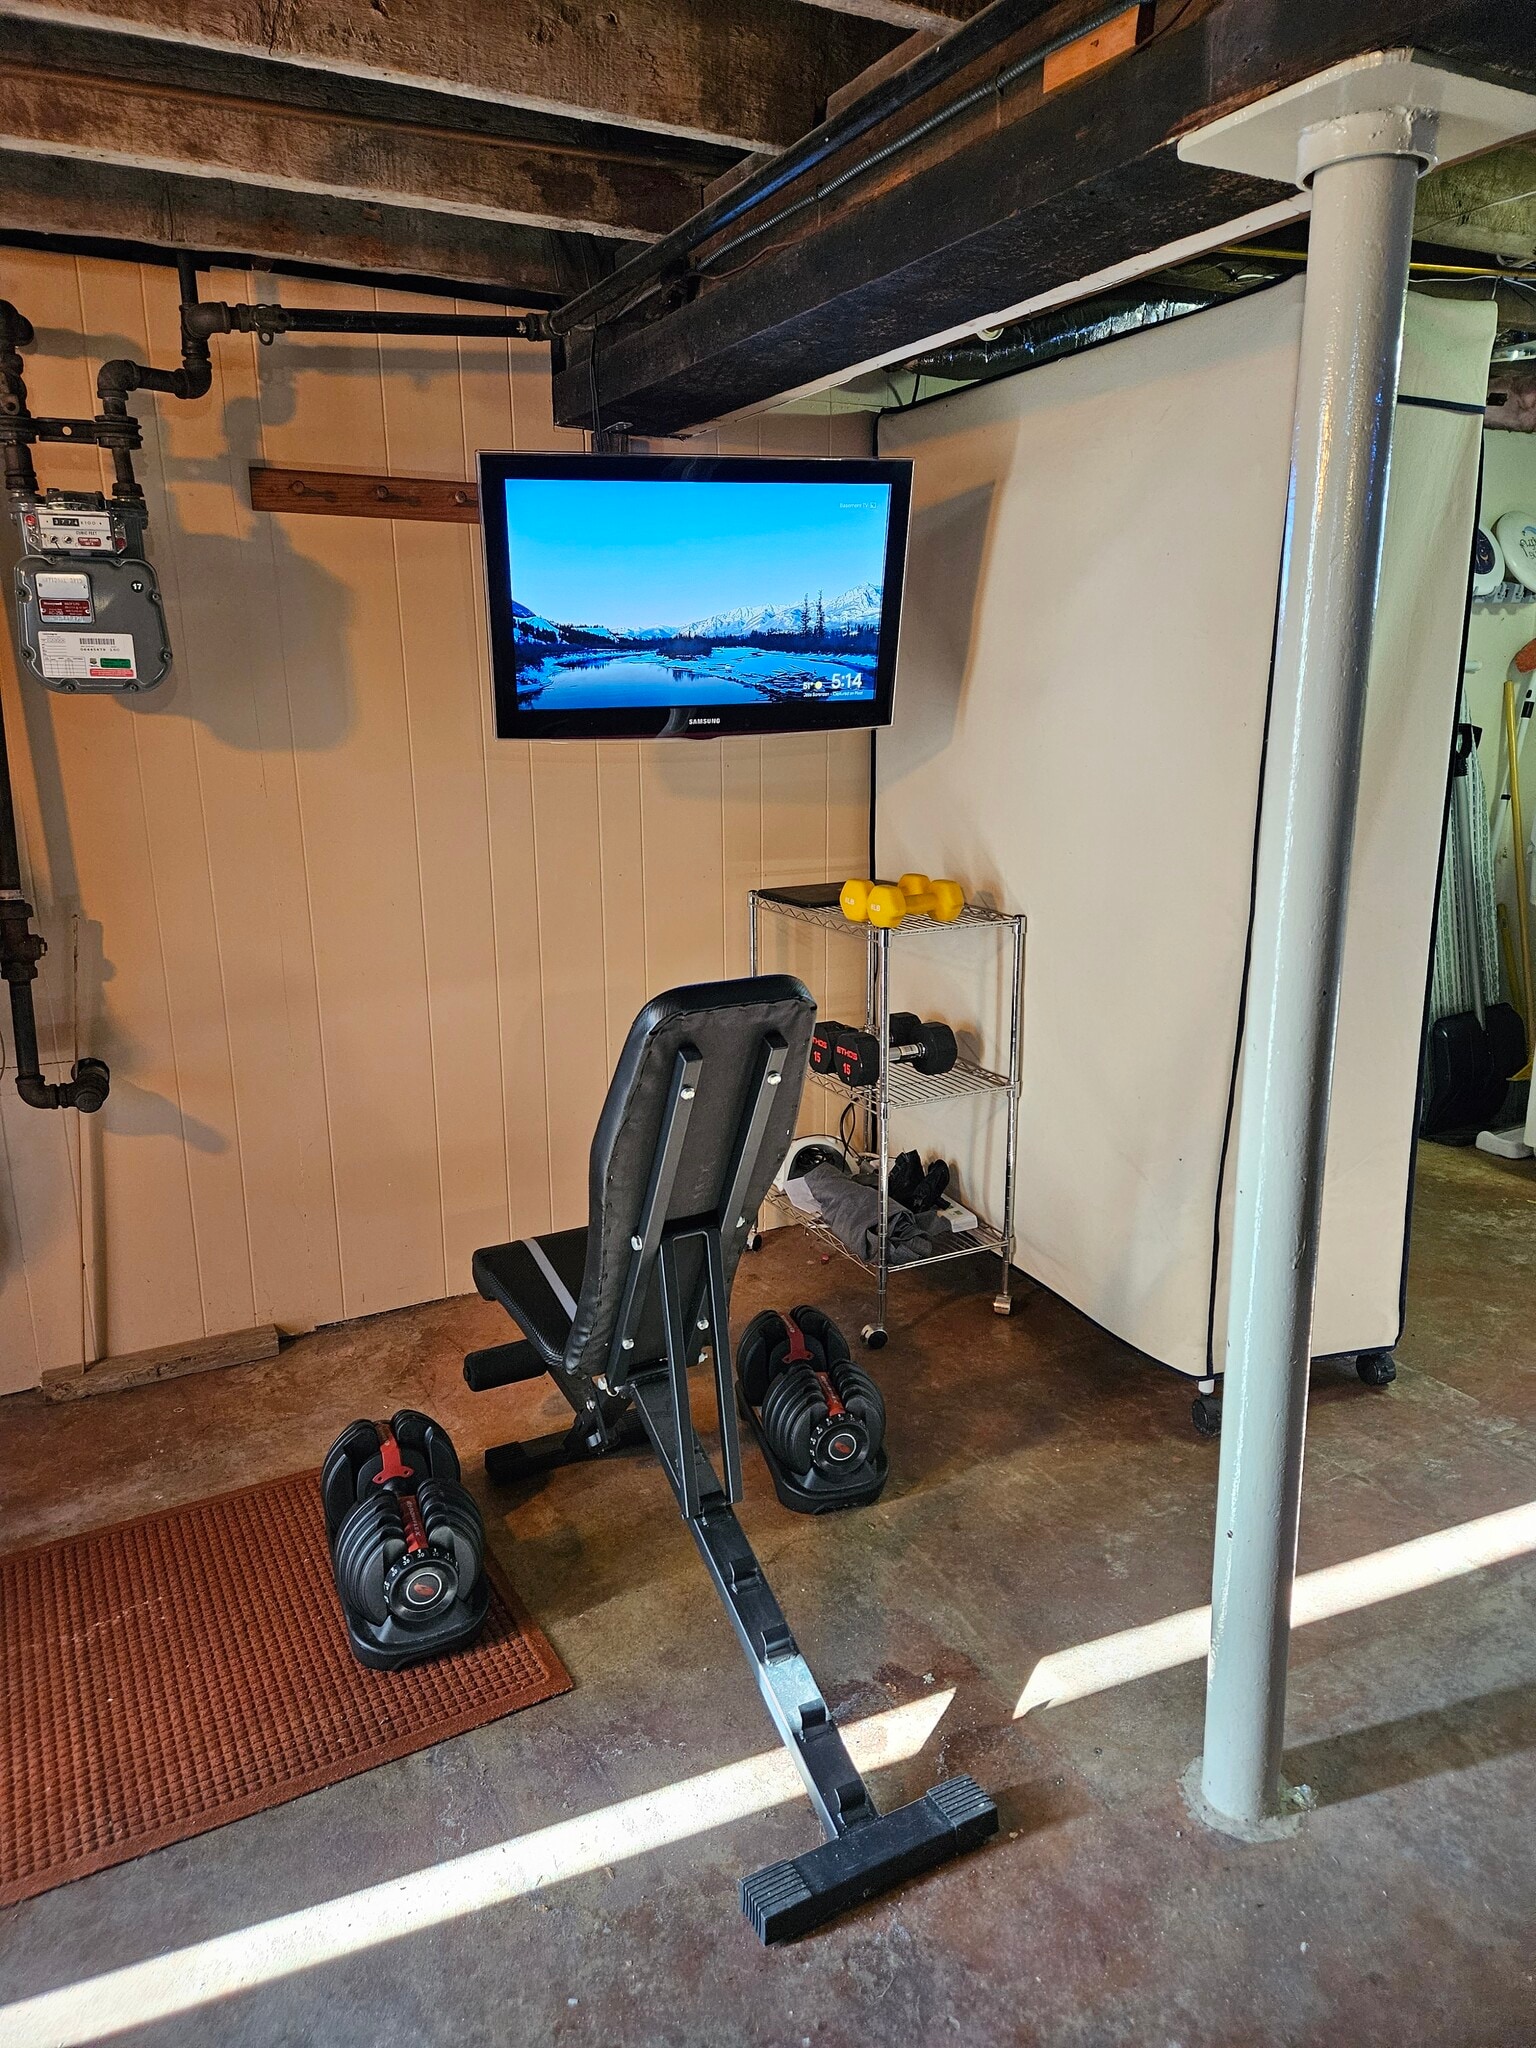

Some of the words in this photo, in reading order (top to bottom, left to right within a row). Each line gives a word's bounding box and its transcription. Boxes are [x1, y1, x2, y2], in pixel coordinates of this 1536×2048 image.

[831, 673, 862, 689] 5:14
[688, 717, 721, 725] SAMSUNG
[812, 1036, 828, 1049] THOS
[813, 1051, 821, 1063] 15
[836, 1045, 858, 1061] ETHOS
[842, 1062, 851, 1075] 15
